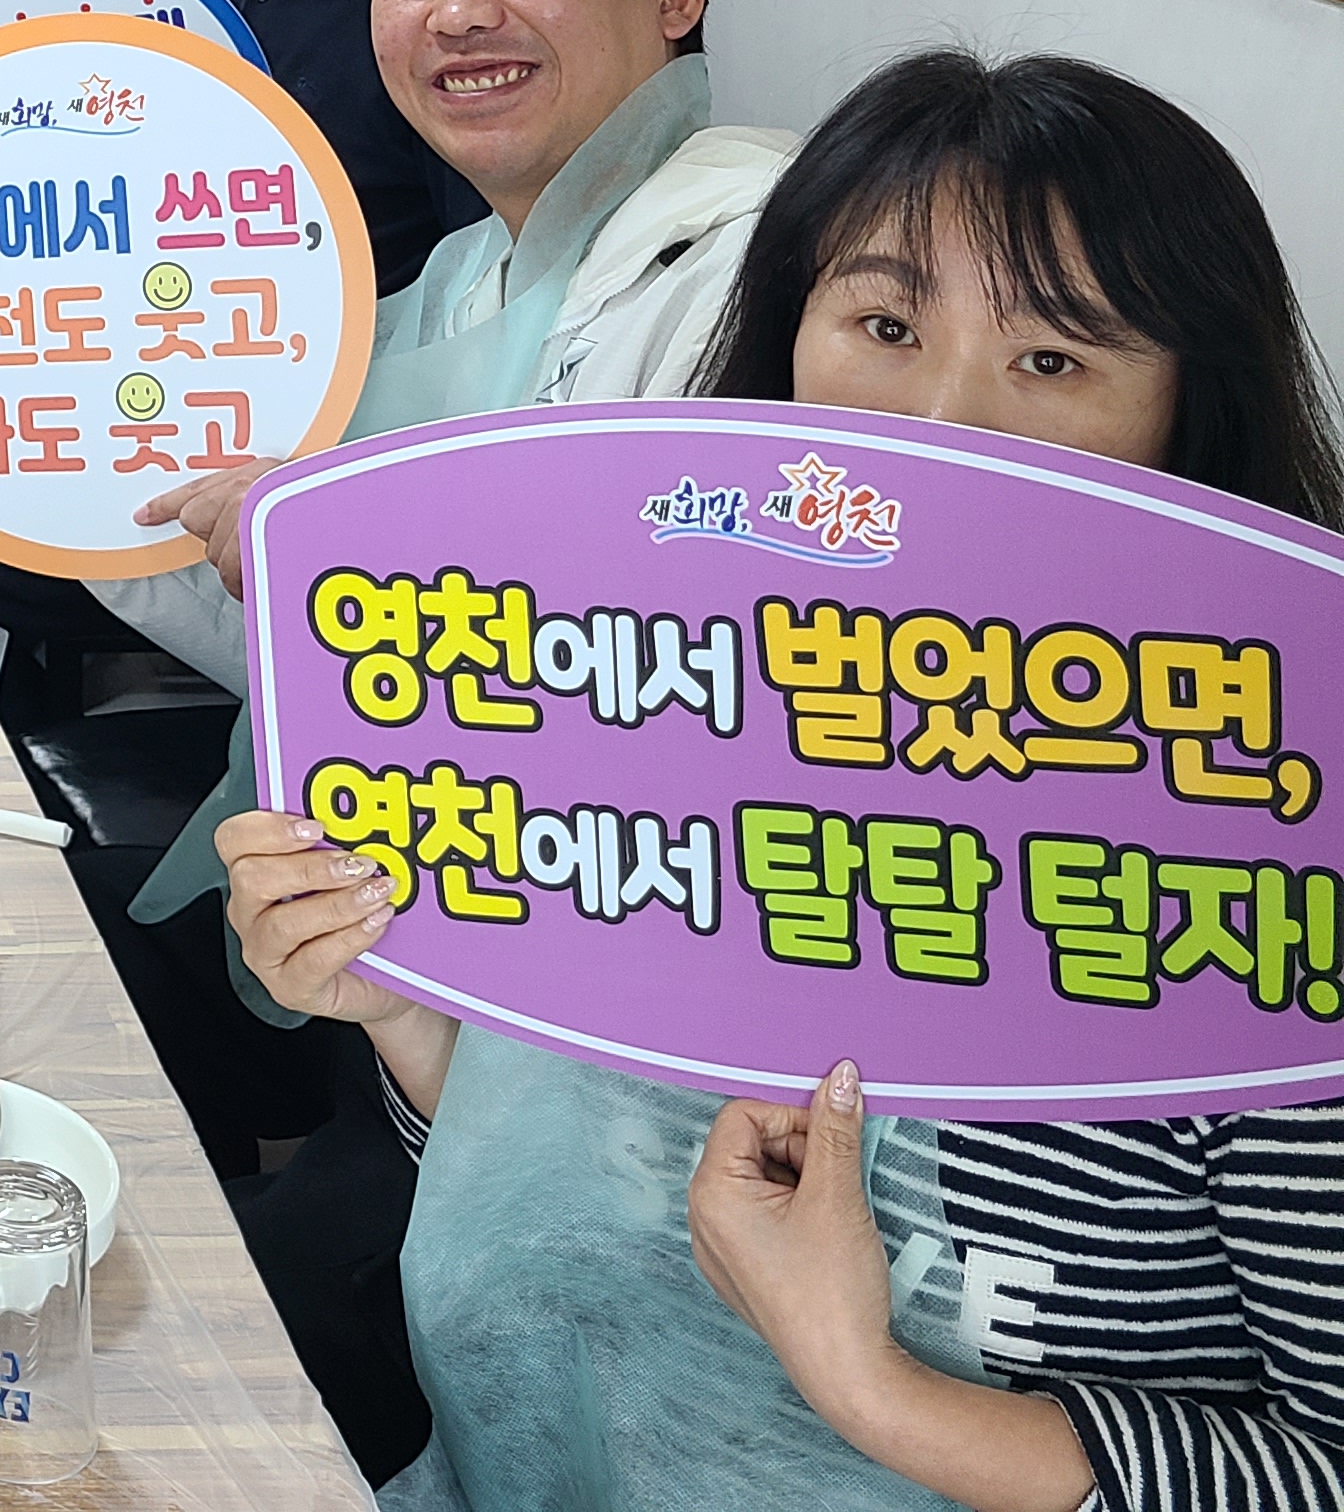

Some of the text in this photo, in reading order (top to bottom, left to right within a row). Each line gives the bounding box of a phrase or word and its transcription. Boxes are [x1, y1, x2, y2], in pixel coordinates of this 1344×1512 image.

[155, 163, 324, 253] 쓰면,
[308, 565, 1322, 825] 영천에서 벌었으면,
[304, 758, 1344, 1025] 영천에서 탈탈 털자!
